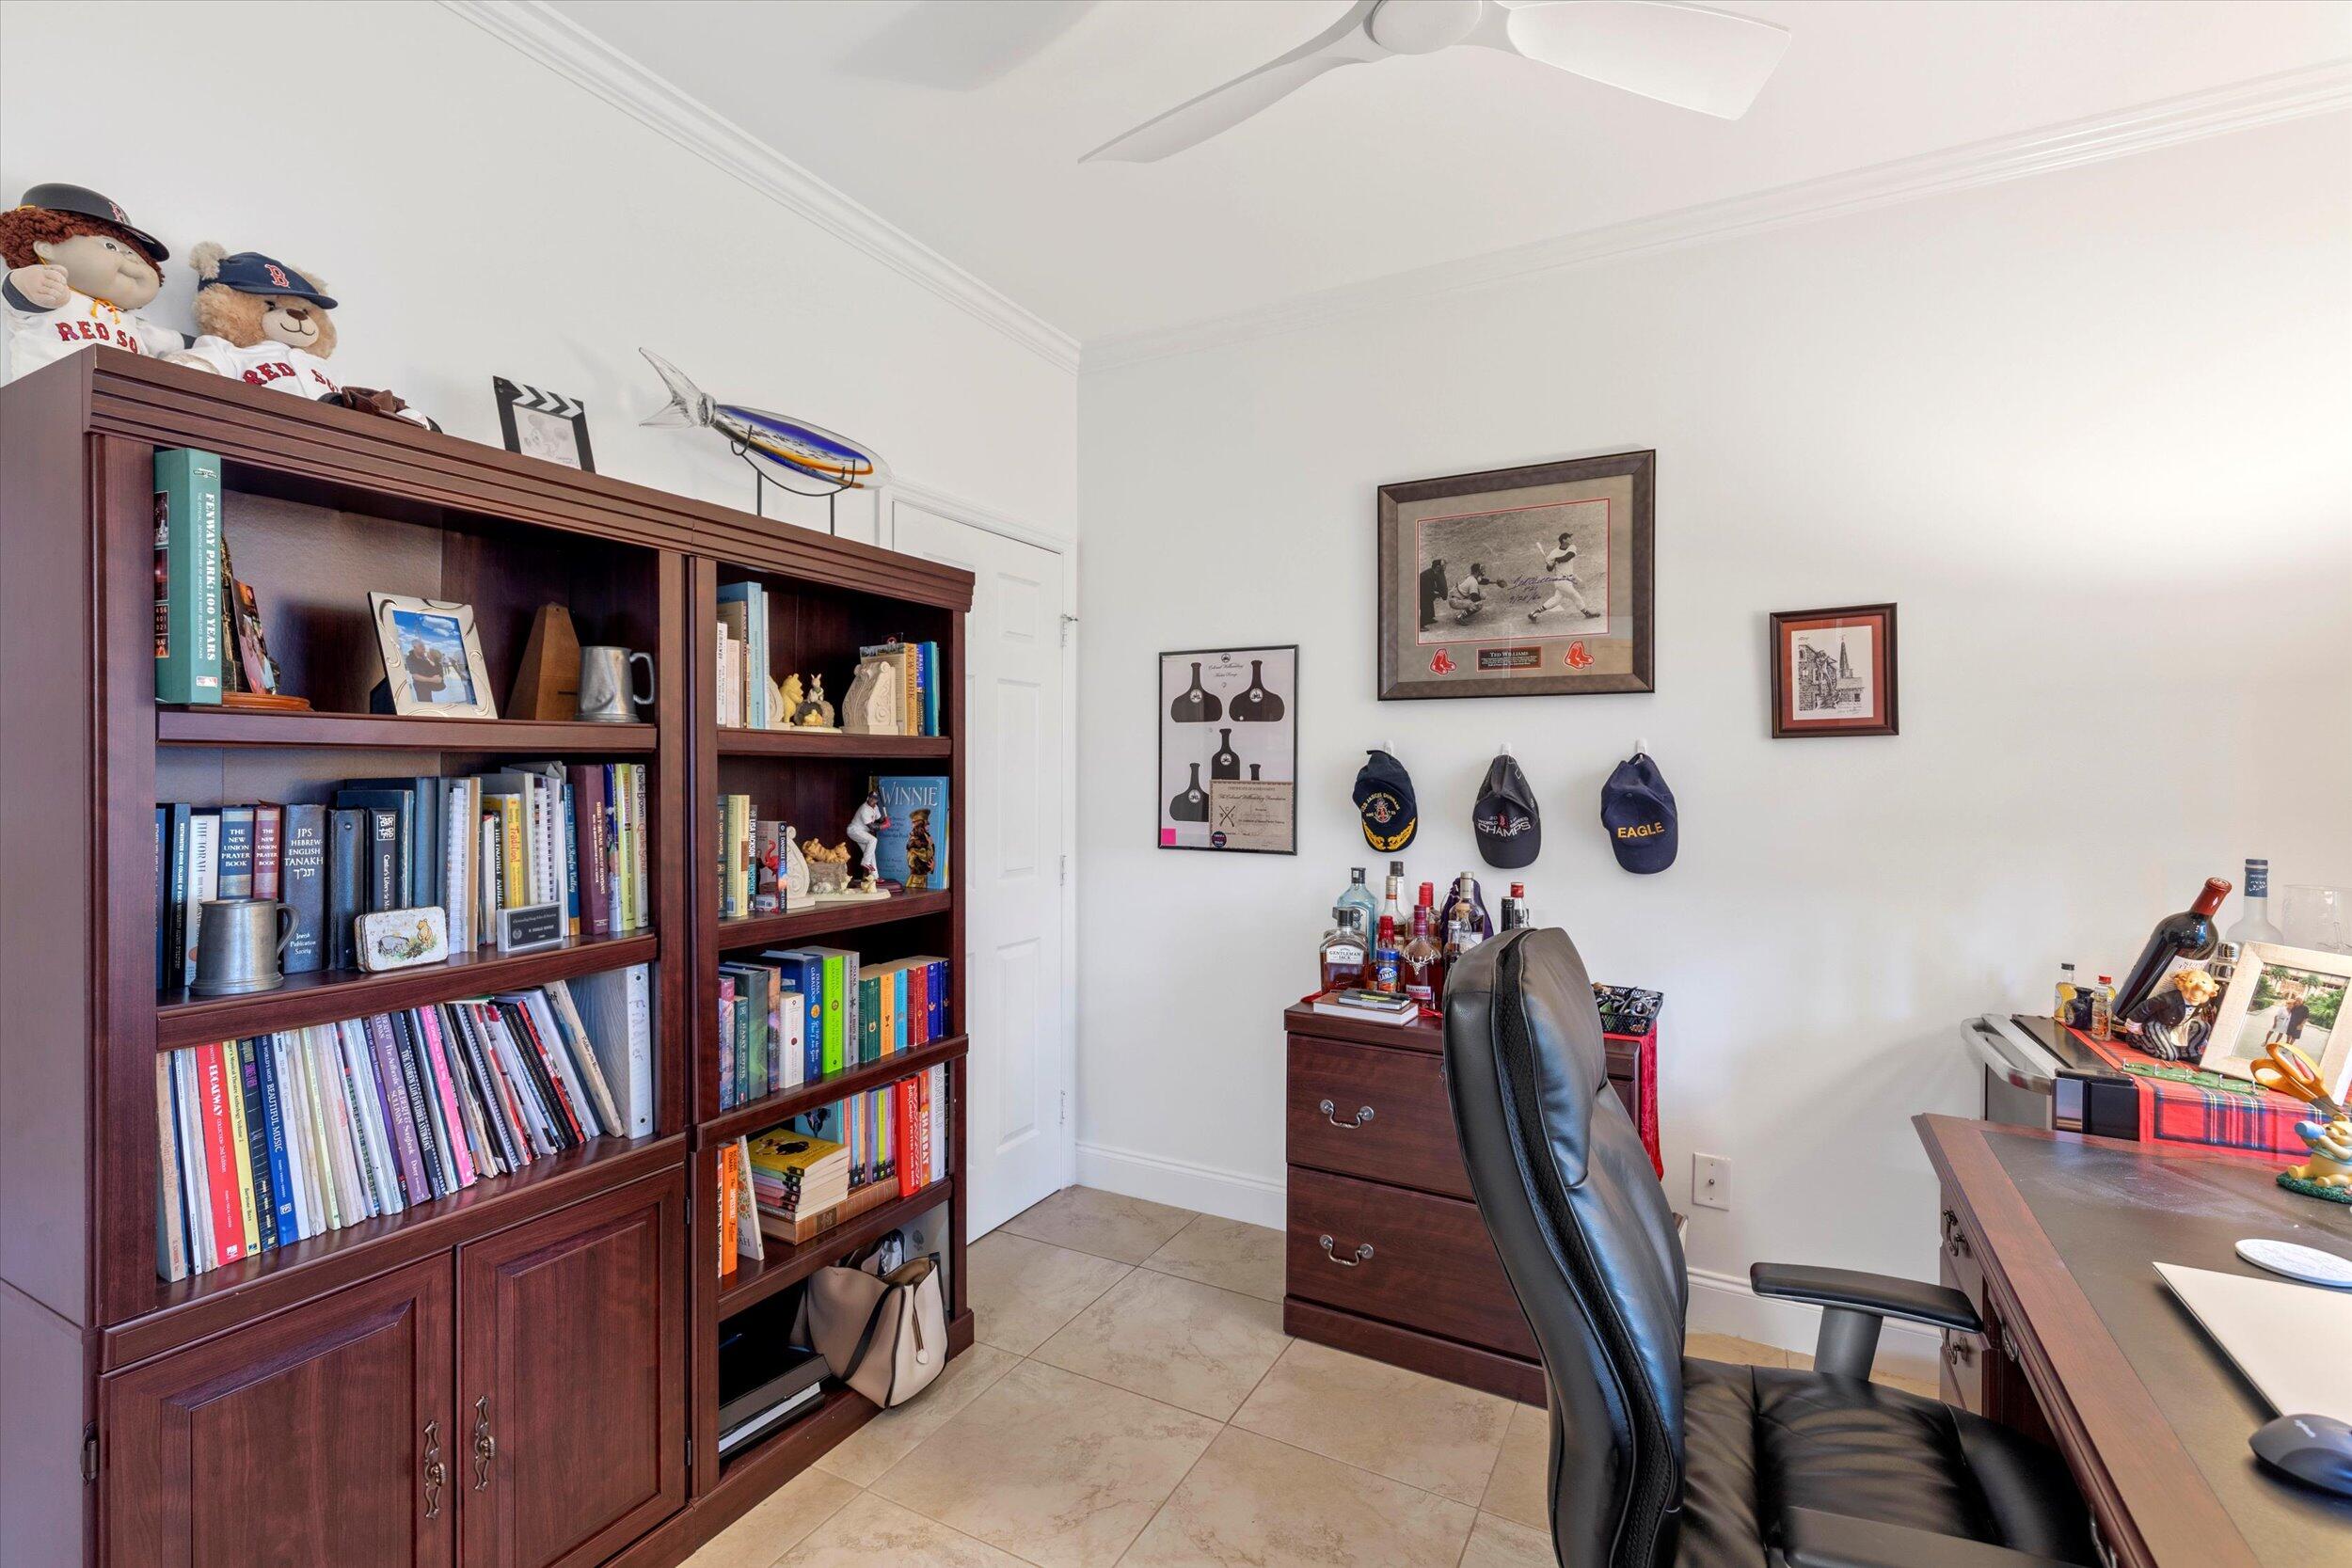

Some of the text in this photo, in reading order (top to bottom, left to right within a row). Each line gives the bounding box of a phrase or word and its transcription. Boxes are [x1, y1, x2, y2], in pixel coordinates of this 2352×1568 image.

[264, 263, 290, 288] B
[56, 321, 138, 355] RED SO
[243, 362, 296, 386] RED
[206, 493, 216, 661] FENWAY PARK: 100 YEARS
[636, 766, 647, 791] Charlie
[637, 792, 647, 817] Brown
[882, 782, 939, 807] WINNIE
[297, 828, 312, 838] JPS
[1478, 821, 1532, 838] CHAMPS
[1617, 821, 1665, 839] EAGLE
[510, 826, 520, 863] Tradition!
[196, 842, 207, 873] TORAH
[284, 857, 324, 866] TANAKH
[749, 863, 757, 895] UNSPOKEN
[230, 1075, 238, 1094] Theatre
[264, 1068, 273, 1082] MOST
[207, 1063, 222, 1117] BROADWAY
[230, 1094, 242, 1120] Anthology
[264, 1082, 280, 1125] BEAUTIFUL
[388, 1089, 405, 1125] SULLIVAN
[271, 1125, 283, 1151] MUSIC
[921, 1111, 930, 1165] SHABBAT
